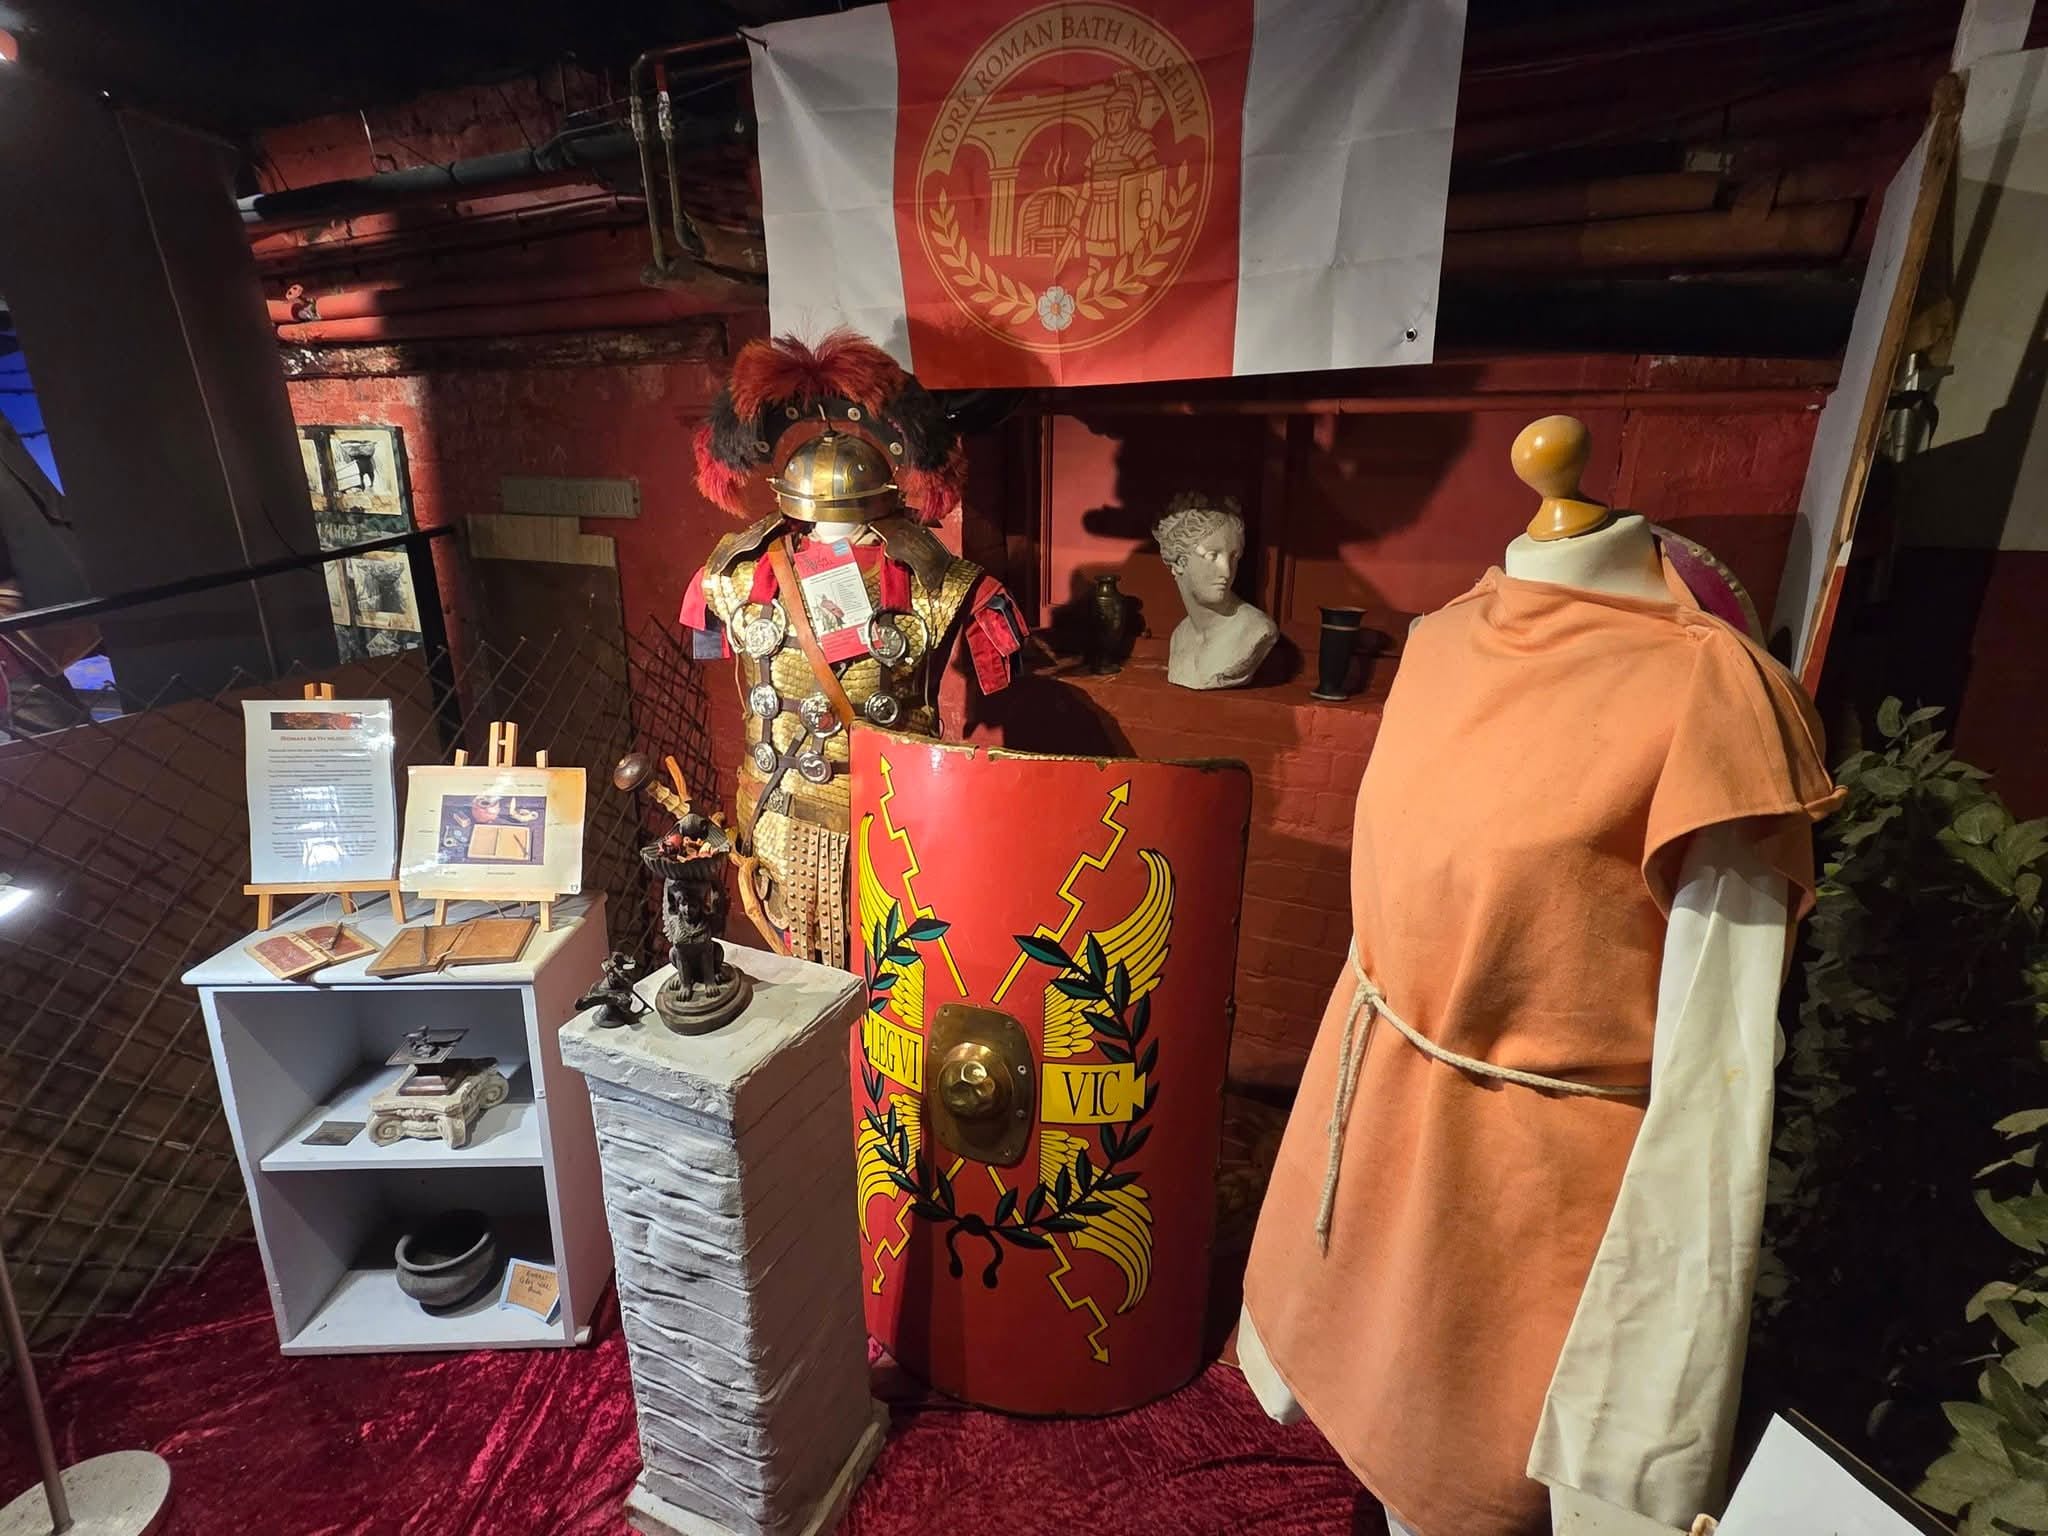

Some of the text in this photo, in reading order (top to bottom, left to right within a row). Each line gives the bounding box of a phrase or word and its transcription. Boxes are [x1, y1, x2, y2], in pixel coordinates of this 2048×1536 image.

[933, 16, 1199, 157] YORK ROMAN BATH MUSEUM
[871, 1018, 919, 1085] LEG VI
[1061, 1070, 1121, 1117] VIC
